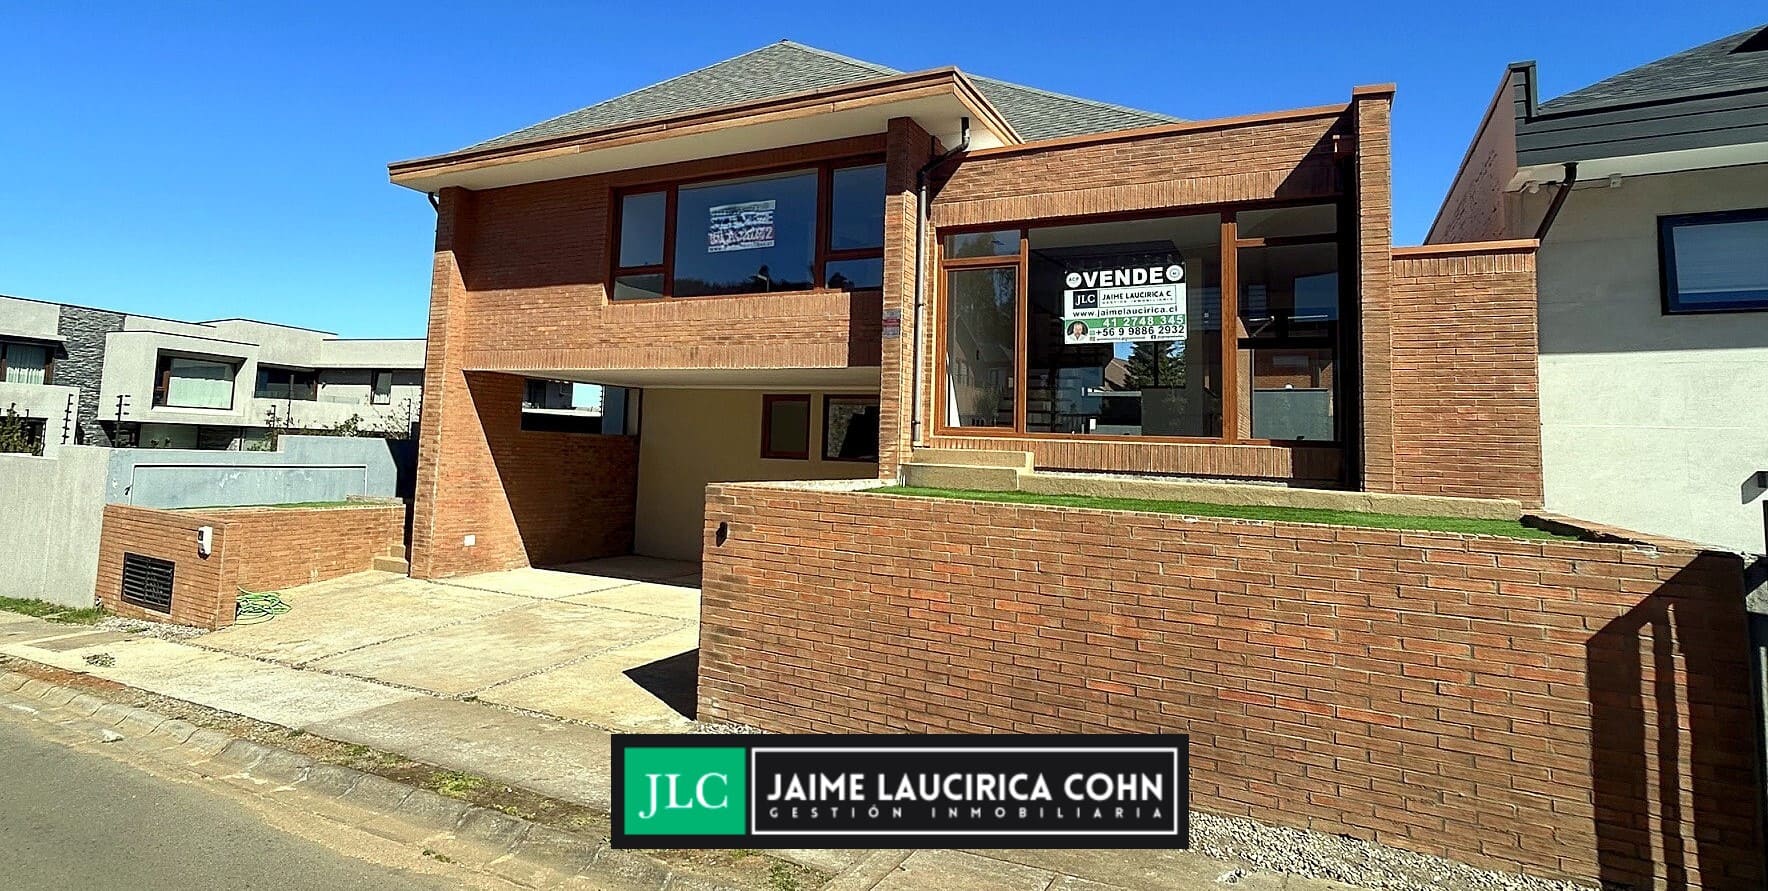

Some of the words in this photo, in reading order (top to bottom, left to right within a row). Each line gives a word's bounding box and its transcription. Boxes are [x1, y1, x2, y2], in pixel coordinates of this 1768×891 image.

[1083, 267, 1164, 287] VENDE
[1075, 294, 1096, 305] JLC
[1125, 291, 1164, 300] LAUCIRICA
[1073, 305, 1177, 317] www.jaimelaucirica.cl
[1103, 318, 1117, 328] 41
[1123, 316, 1154, 327] 2748
[1160, 314, 1184, 325] 345
[1096, 327, 1115, 337] +56
[1118, 327, 1125, 336] 9
[1128, 326, 1155, 336] 9886
[1158, 325, 1185, 335] 2932
